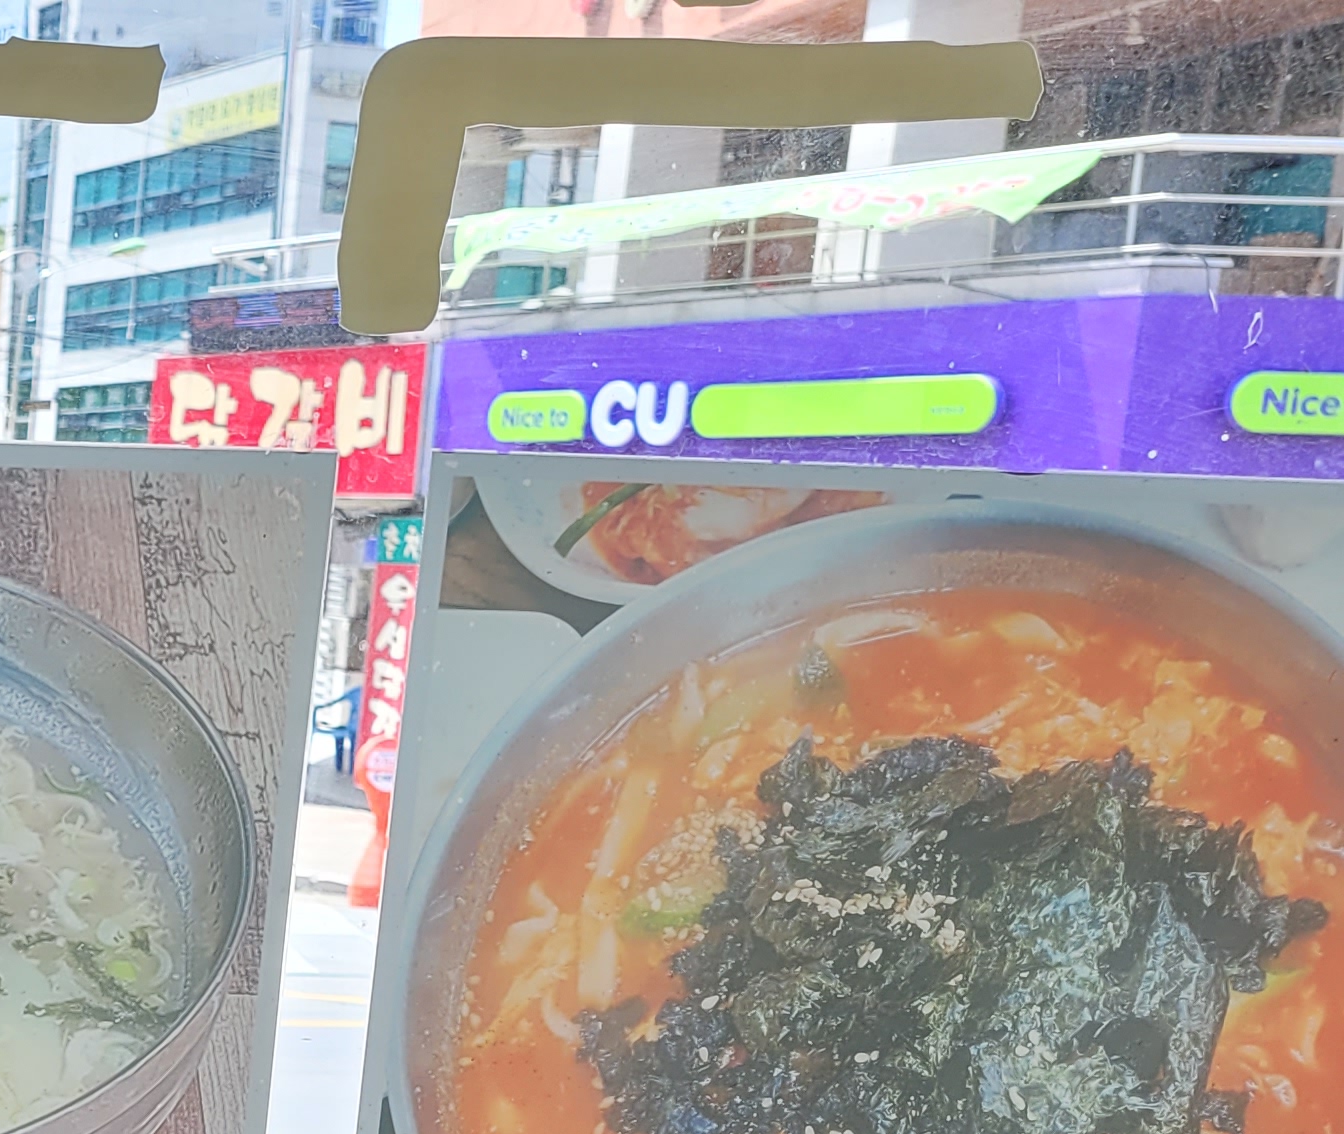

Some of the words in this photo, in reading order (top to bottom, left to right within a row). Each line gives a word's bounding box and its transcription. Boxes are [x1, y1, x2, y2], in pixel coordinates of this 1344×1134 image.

[501, 406, 544, 429] Nice
[550, 407, 569, 428] to
[591, 379, 689, 448] CU
[1260, 386, 1341, 417] Nice
